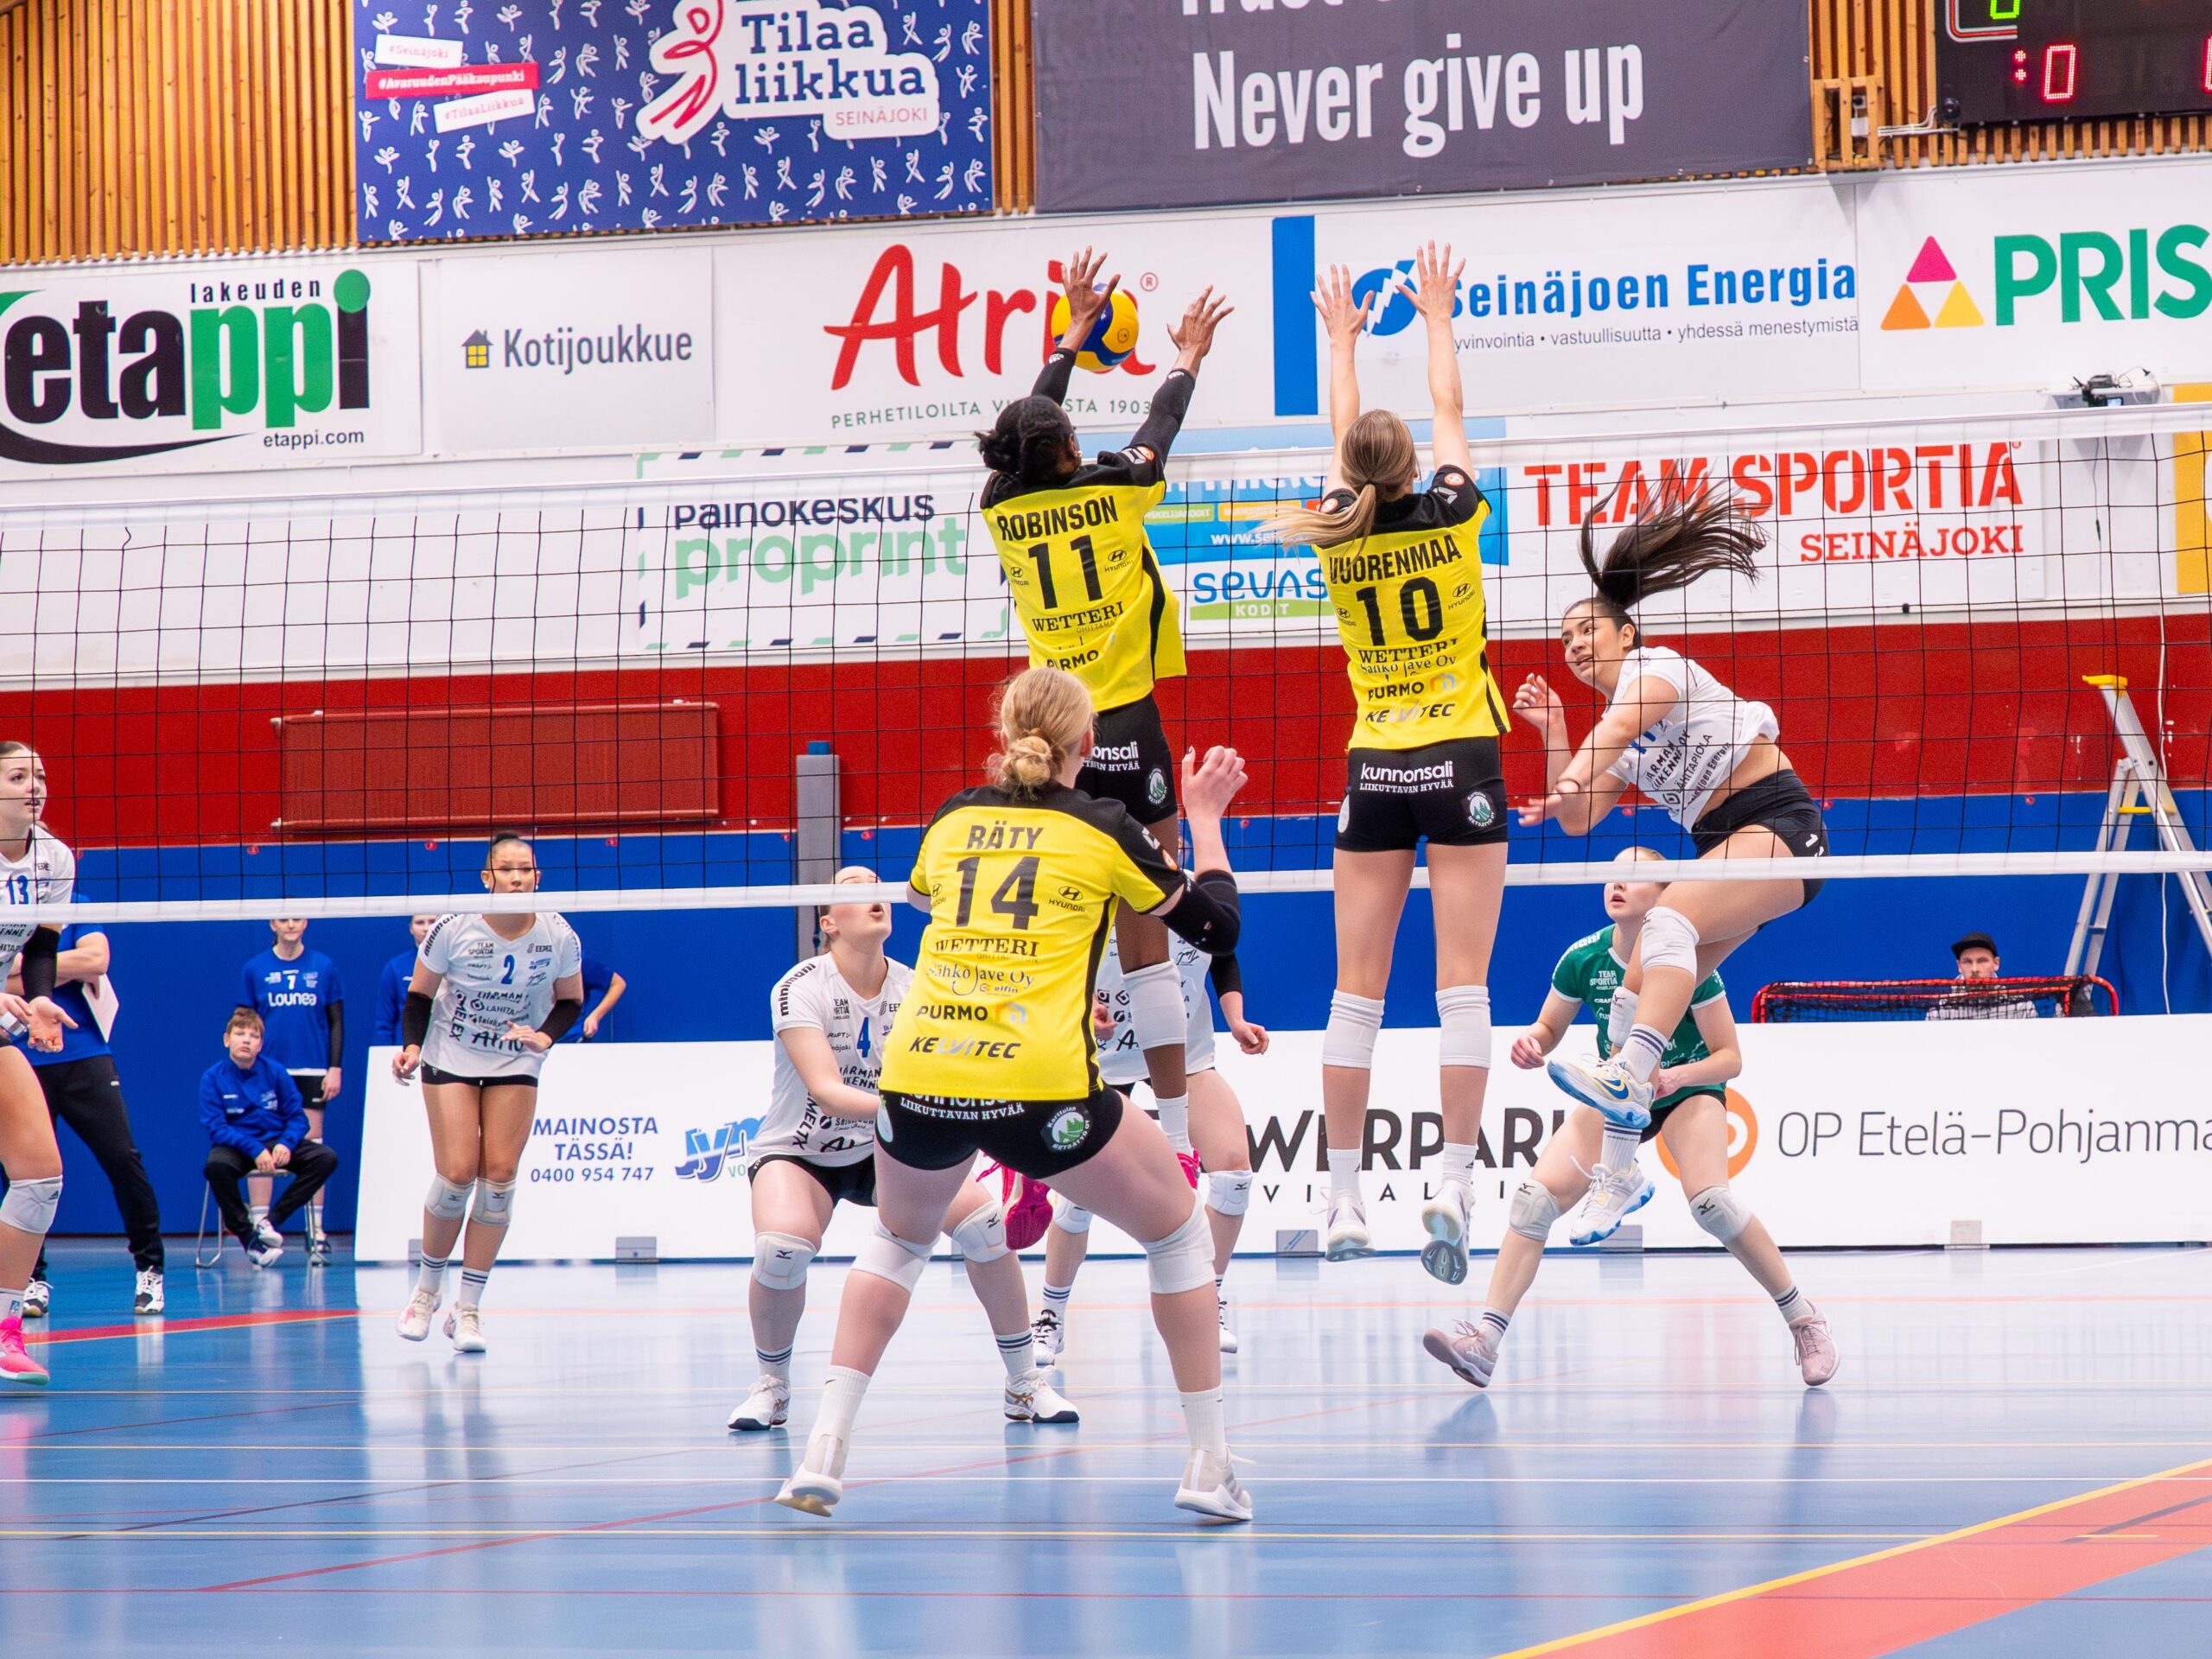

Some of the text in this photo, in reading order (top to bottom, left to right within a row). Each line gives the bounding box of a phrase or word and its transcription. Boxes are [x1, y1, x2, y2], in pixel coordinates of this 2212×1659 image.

[741, 10, 874, 54] Tilaa
[735, 58, 925, 104] liikkua
[1193, 33, 1643, 158] Never give up
[836, 106, 927, 126] SEINÄJOKI
[190, 278, 321, 304] lakeuden
[1688, 257, 1856, 307] Energia
[823, 244, 1156, 391] Atri
[4, 269, 371, 429] etappi
[505, 323, 692, 375] Kotijoukkue
[1453, 316, 1859, 353] yvinvointia vastuullisuutta yhdessä menestymistä
[832, 401, 982, 429] PERHETILOILTA
[1109, 399, 1150, 415] 1903
[263, 429, 365, 450] etappi.com
[1524, 442, 2024, 526] TEAM SPORTIA
[997, 495, 1118, 542] ROBINSON
[1800, 522, 2024, 563] SEINÄJOKI
[676, 518, 966, 600] proprint
[1027, 535, 1103, 610] 11
[1329, 534, 1463, 585] VUORENMAA
[1032, 601, 1124, 632] WETTERI
[1236, 603, 1289, 617] KODIT
[1356, 576, 1444, 646] 10
[1368, 681, 1425, 702] PURMO
[1365, 702, 1455, 723] KELVITEC
[1091, 741, 1139, 760] onsali
[1109, 760, 1141, 772] HYVÄÄ
[1361, 760, 1453, 783] kunnonsali
[1359, 779, 1454, 793] LIIKUTTAVAN HYVÄÄ
[967, 820, 1044, 849] RÄTY
[957, 856, 1040, 931] 14
[1048, 899, 1086, 912] HYUNDAI
[936, 938, 1039, 957] WETTERI
[501, 954, 515, 985] 2
[1009, 969, 1035, 989] Oy
[1599, 969, 1617, 978] TEAM
[268, 992, 317, 1007] Lounea
[779, 963, 817, 1017] minimani
[917, 1005, 988, 1021] PURMO
[856, 1016, 871, 1058] 4
[909, 1037, 1020, 1059] KELVITEC
[900, 1098, 978, 1120] LIIKUTTAVAN
[982, 1102, 1025, 1120] HYVÄÄ
[532, 1116, 658, 1135] MAINOSTA
[1777, 1112, 1842, 1157] OP
[554, 1137, 633, 1160] TÄSSÄ!
[531, 1166, 654, 1182] 0400 954 747
